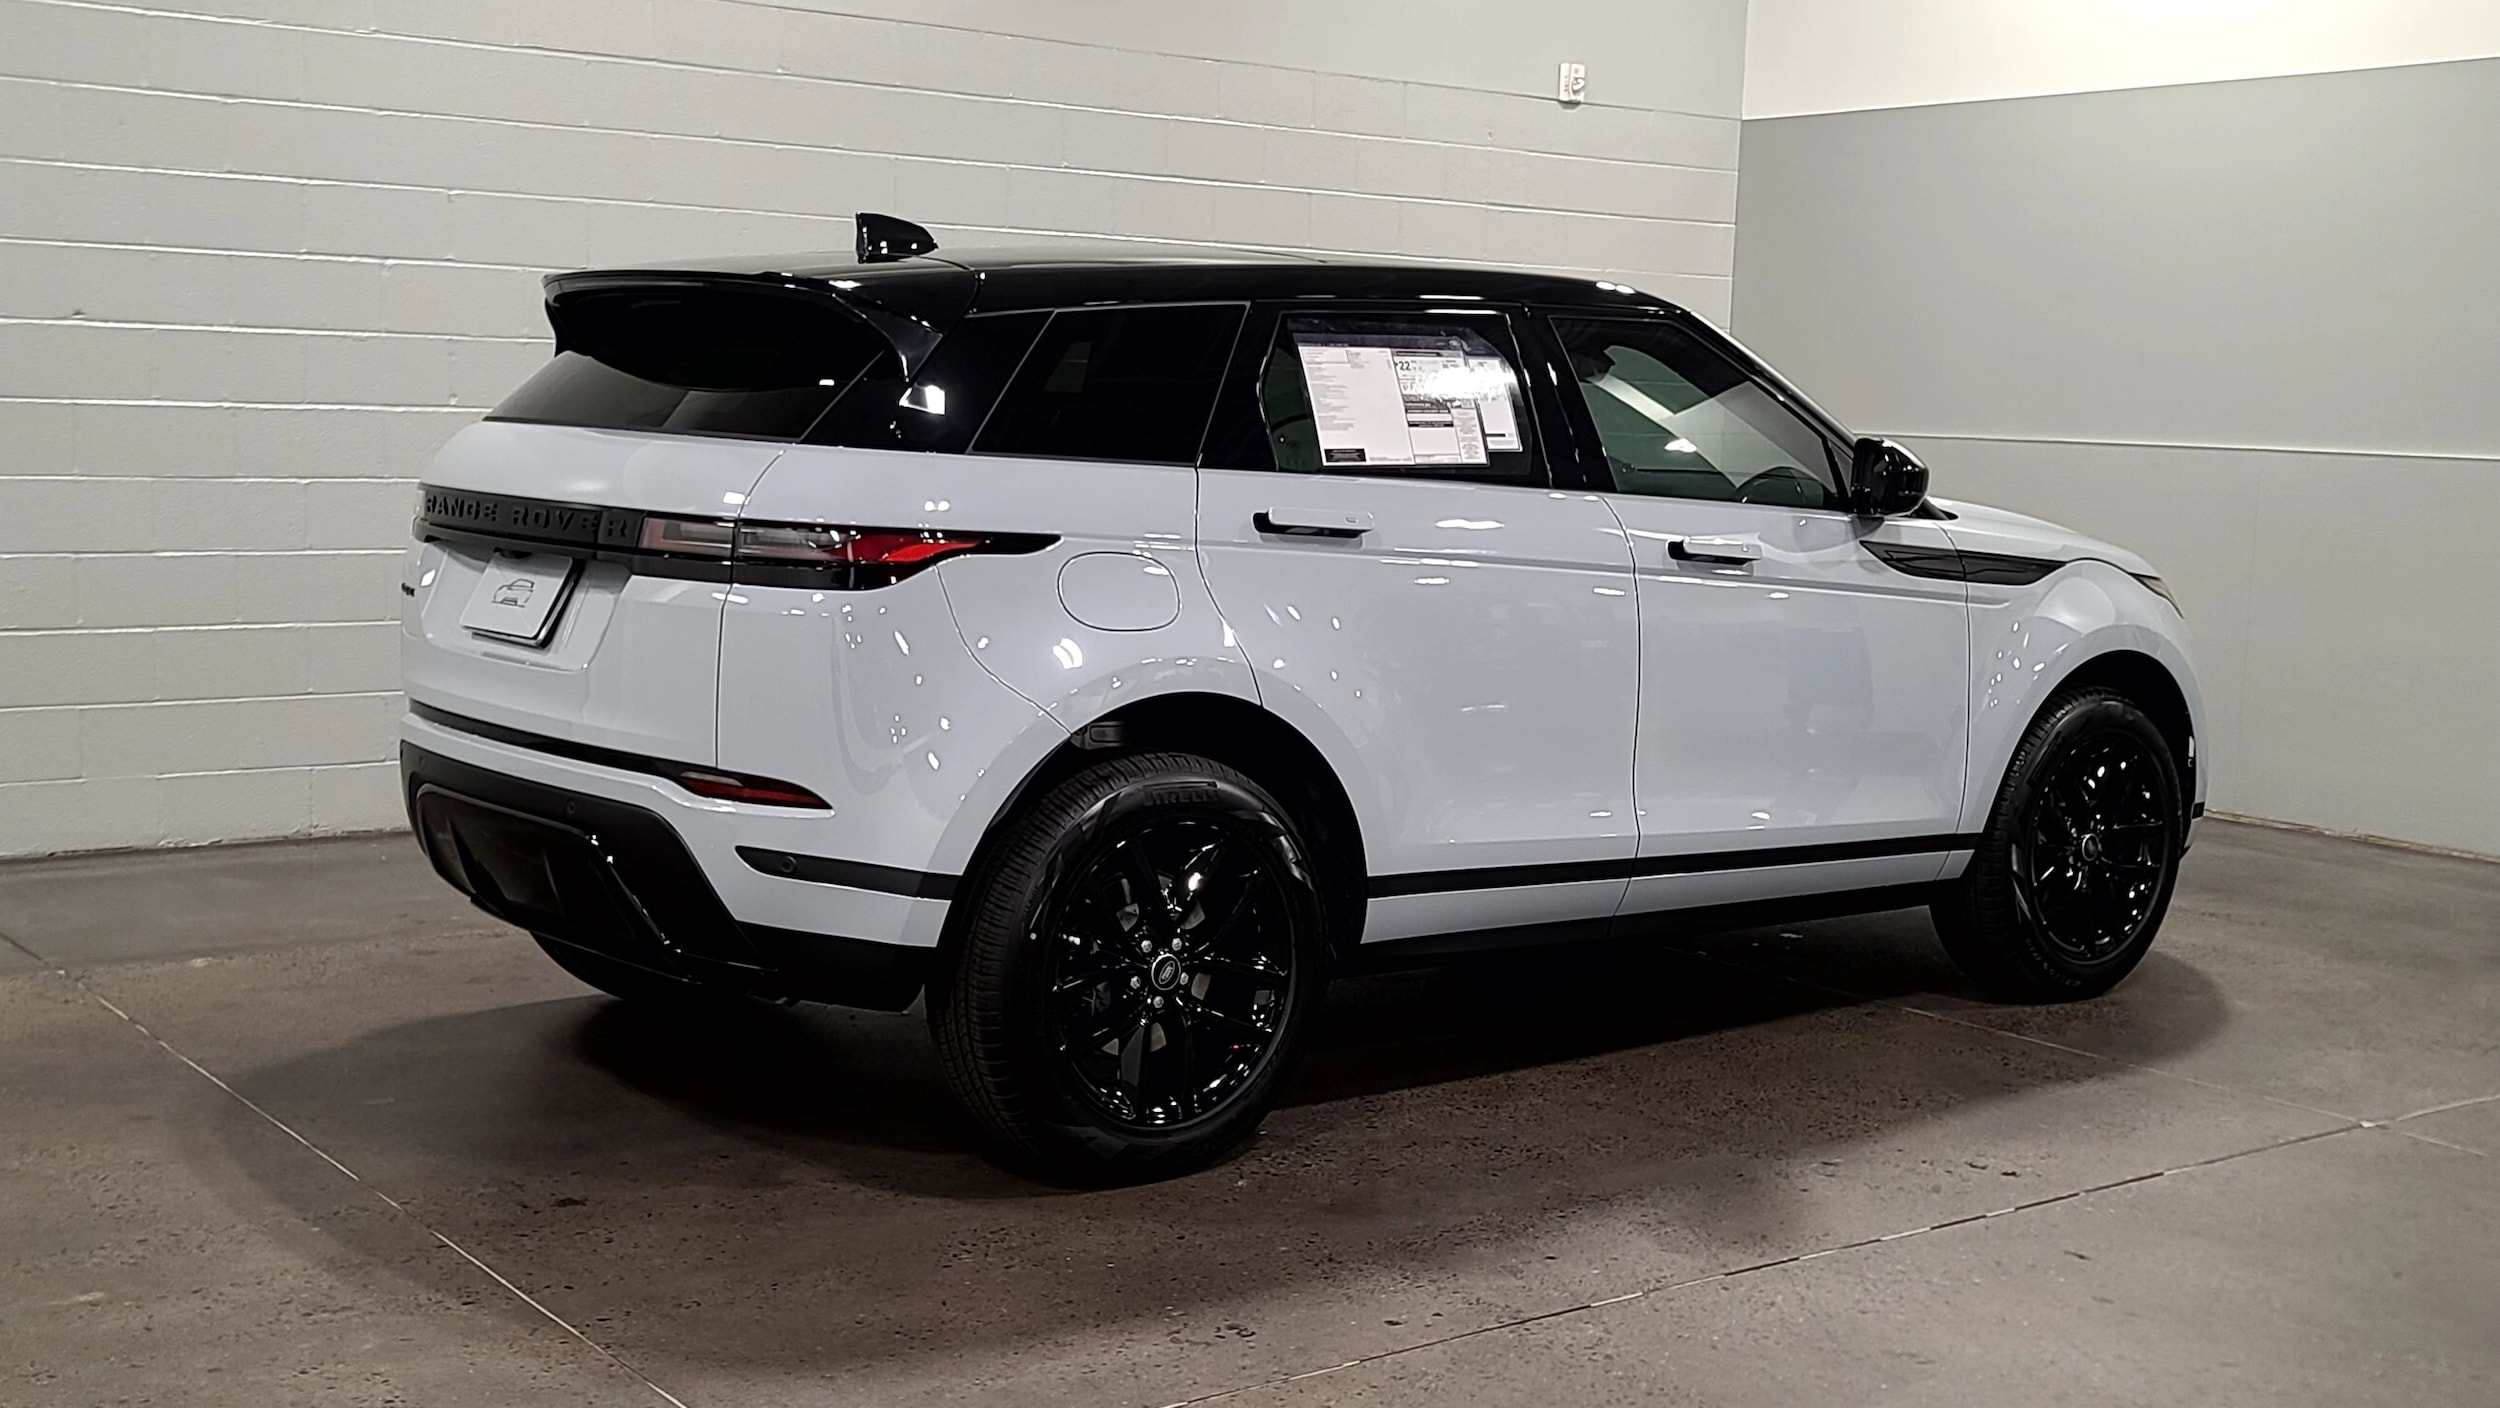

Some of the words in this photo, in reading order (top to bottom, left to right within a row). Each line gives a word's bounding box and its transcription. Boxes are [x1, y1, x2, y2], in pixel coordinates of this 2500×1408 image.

[1398, 360, 1411, 371] 22
[425, 494, 498, 522] RANGE
[513, 507, 628, 538] ROVER
